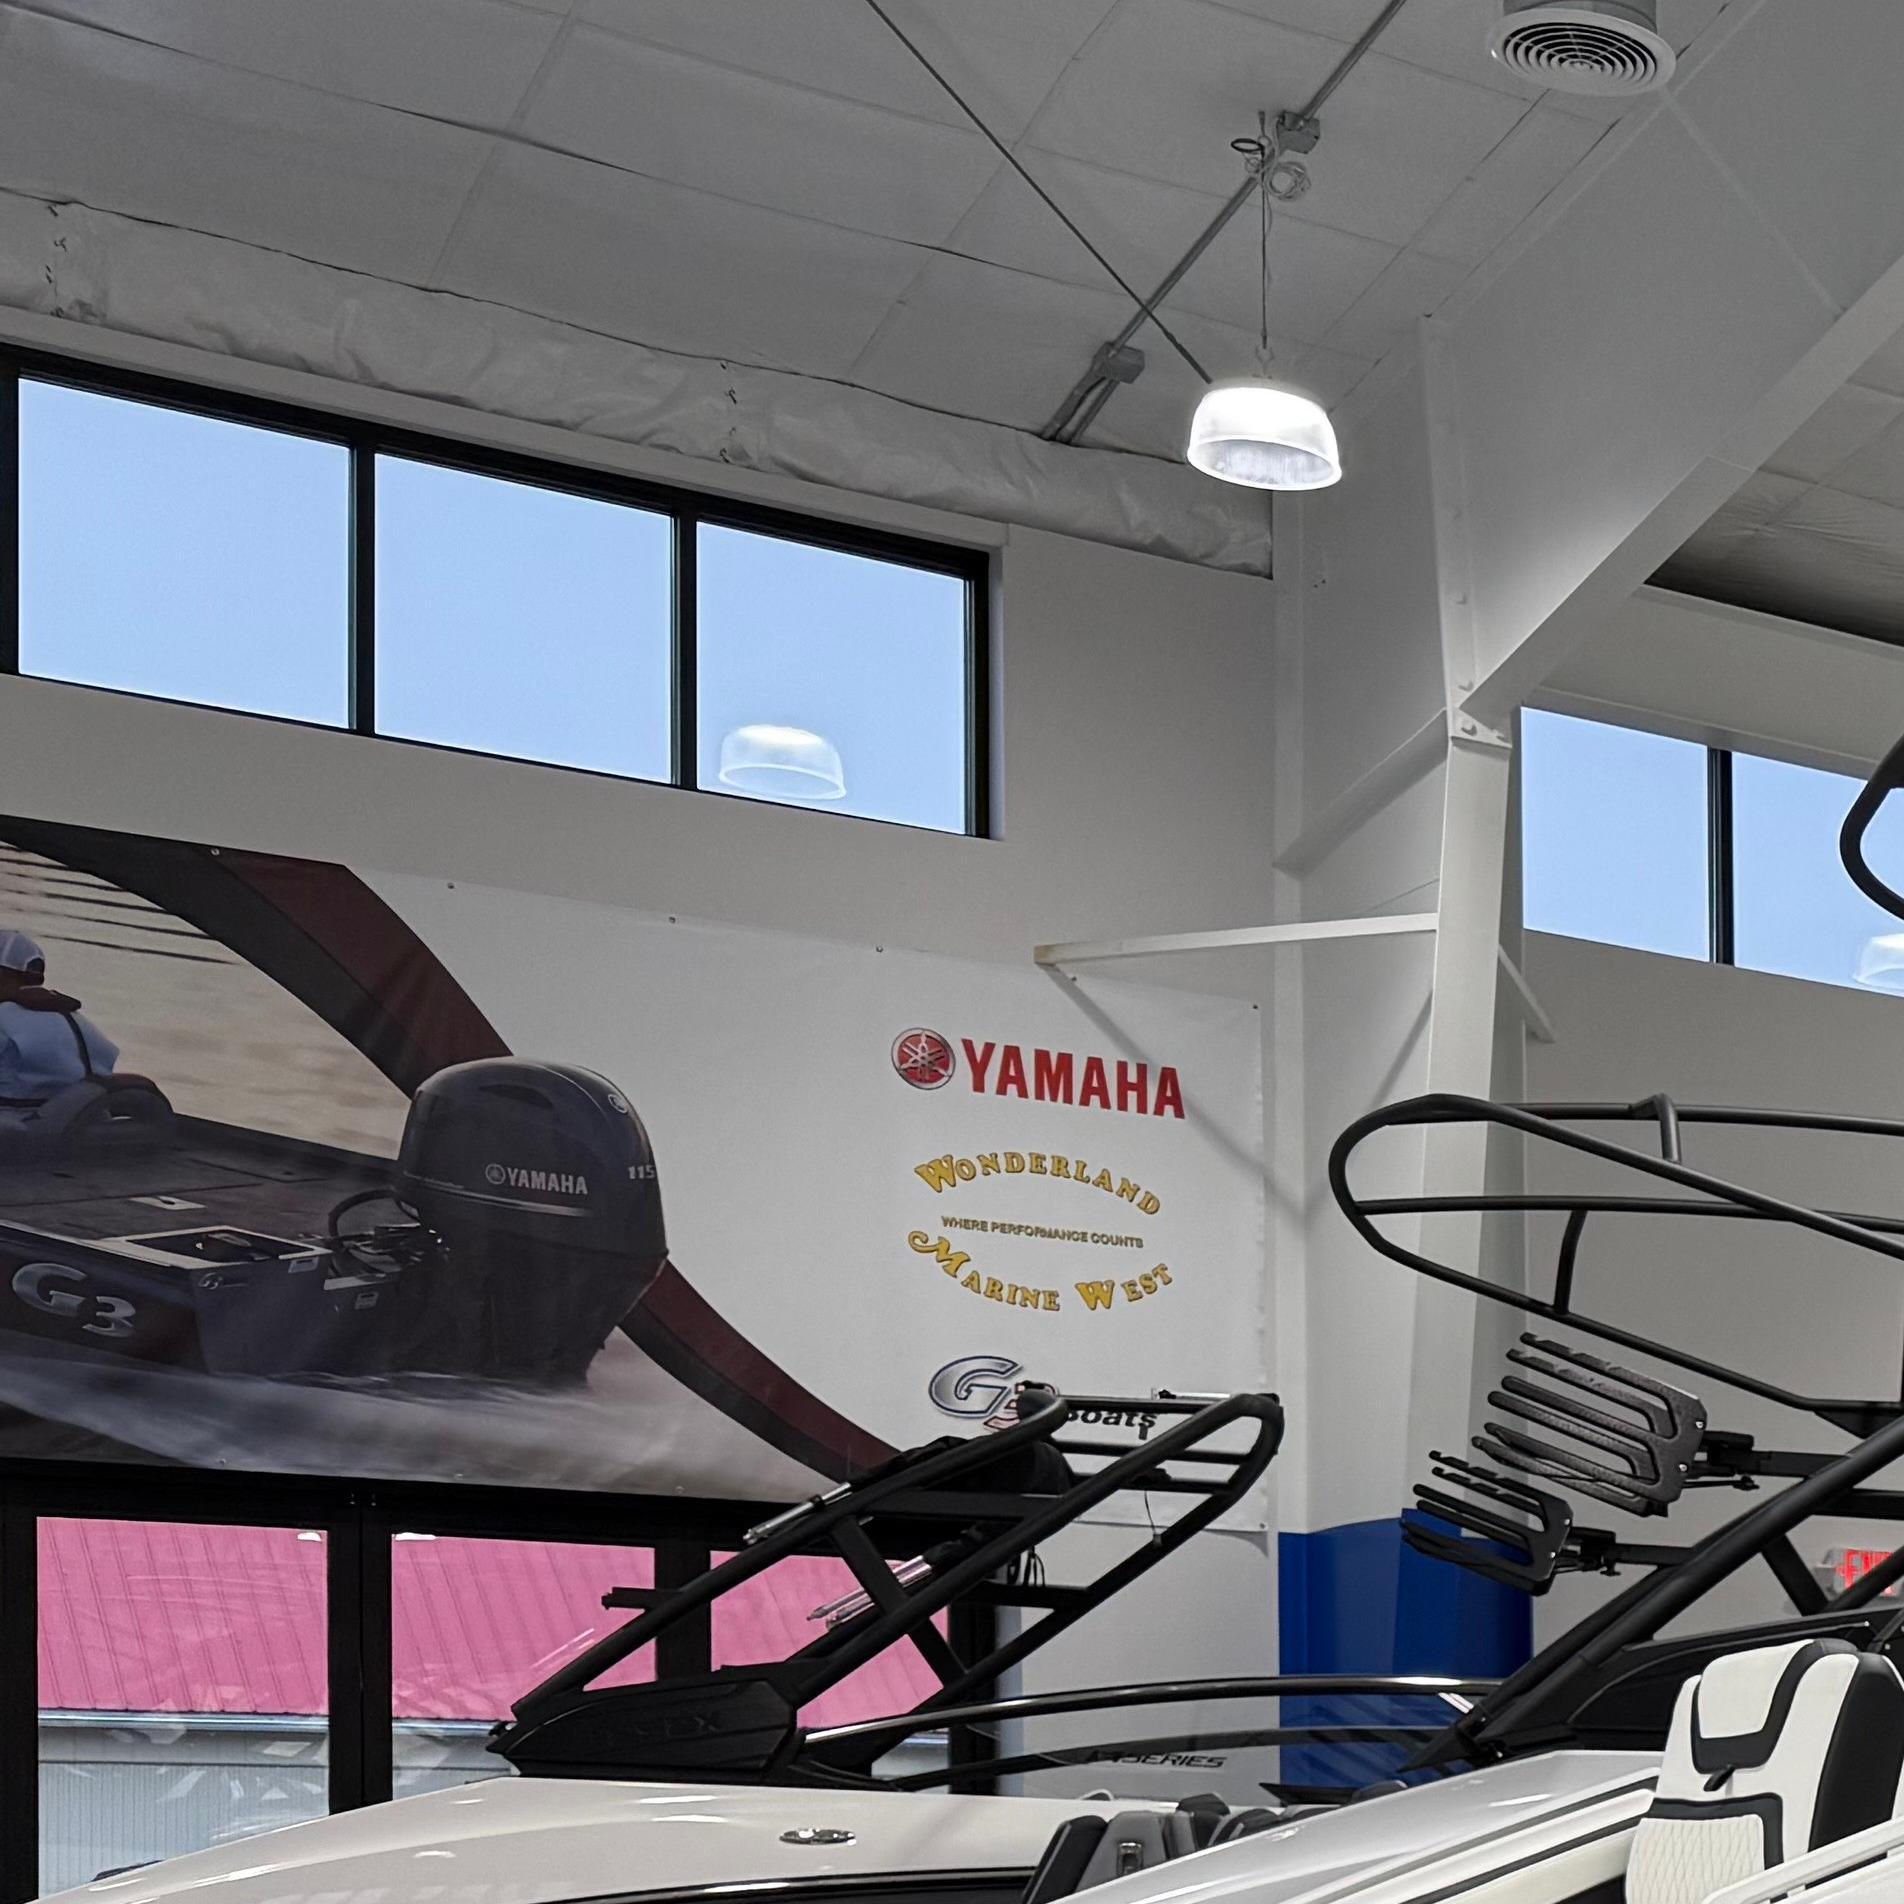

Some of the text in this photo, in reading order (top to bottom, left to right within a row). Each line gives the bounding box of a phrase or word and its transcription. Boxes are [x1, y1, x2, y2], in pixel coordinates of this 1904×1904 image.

[961, 1038, 1185, 1120] YAMAHA
[507, 1167, 588, 1195] YAMAHA
[627, 1164, 656, 1179] 115
[913, 1151, 1161, 1215] WONDERLAND
[941, 1215, 1144, 1249] WHERE PERFORMANCE COUNTS
[908, 1230, 1173, 1311] MARINE WEST
[12, 1262, 137, 1338] G3
[1066, 1407, 1158, 1428] oats
